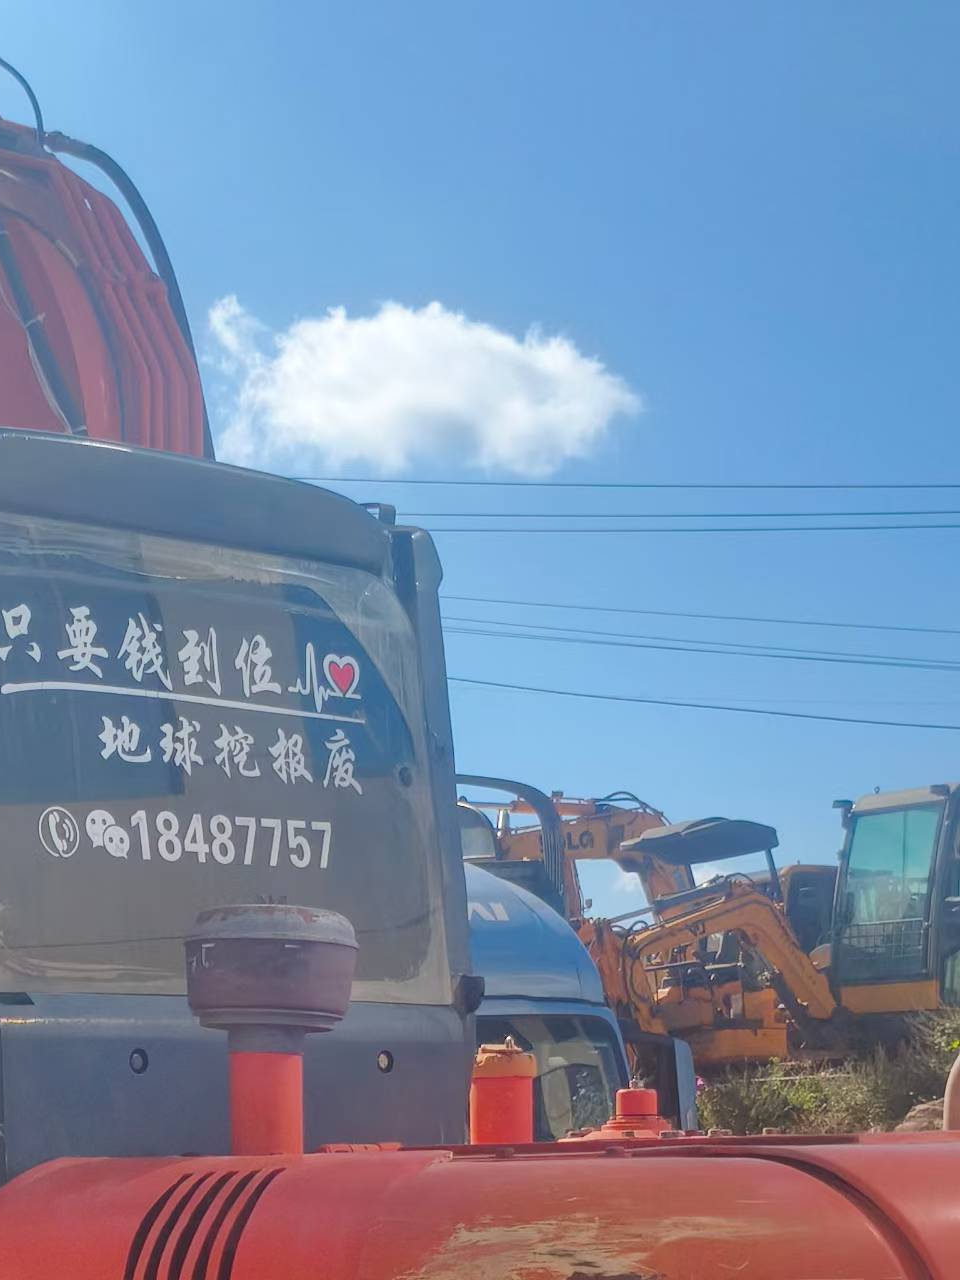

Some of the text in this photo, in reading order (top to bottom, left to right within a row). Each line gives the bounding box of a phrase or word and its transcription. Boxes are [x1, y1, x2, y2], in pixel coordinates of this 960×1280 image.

[97, 715, 363, 796] 地球挖报废
[130, 809, 333, 869] 18487757
